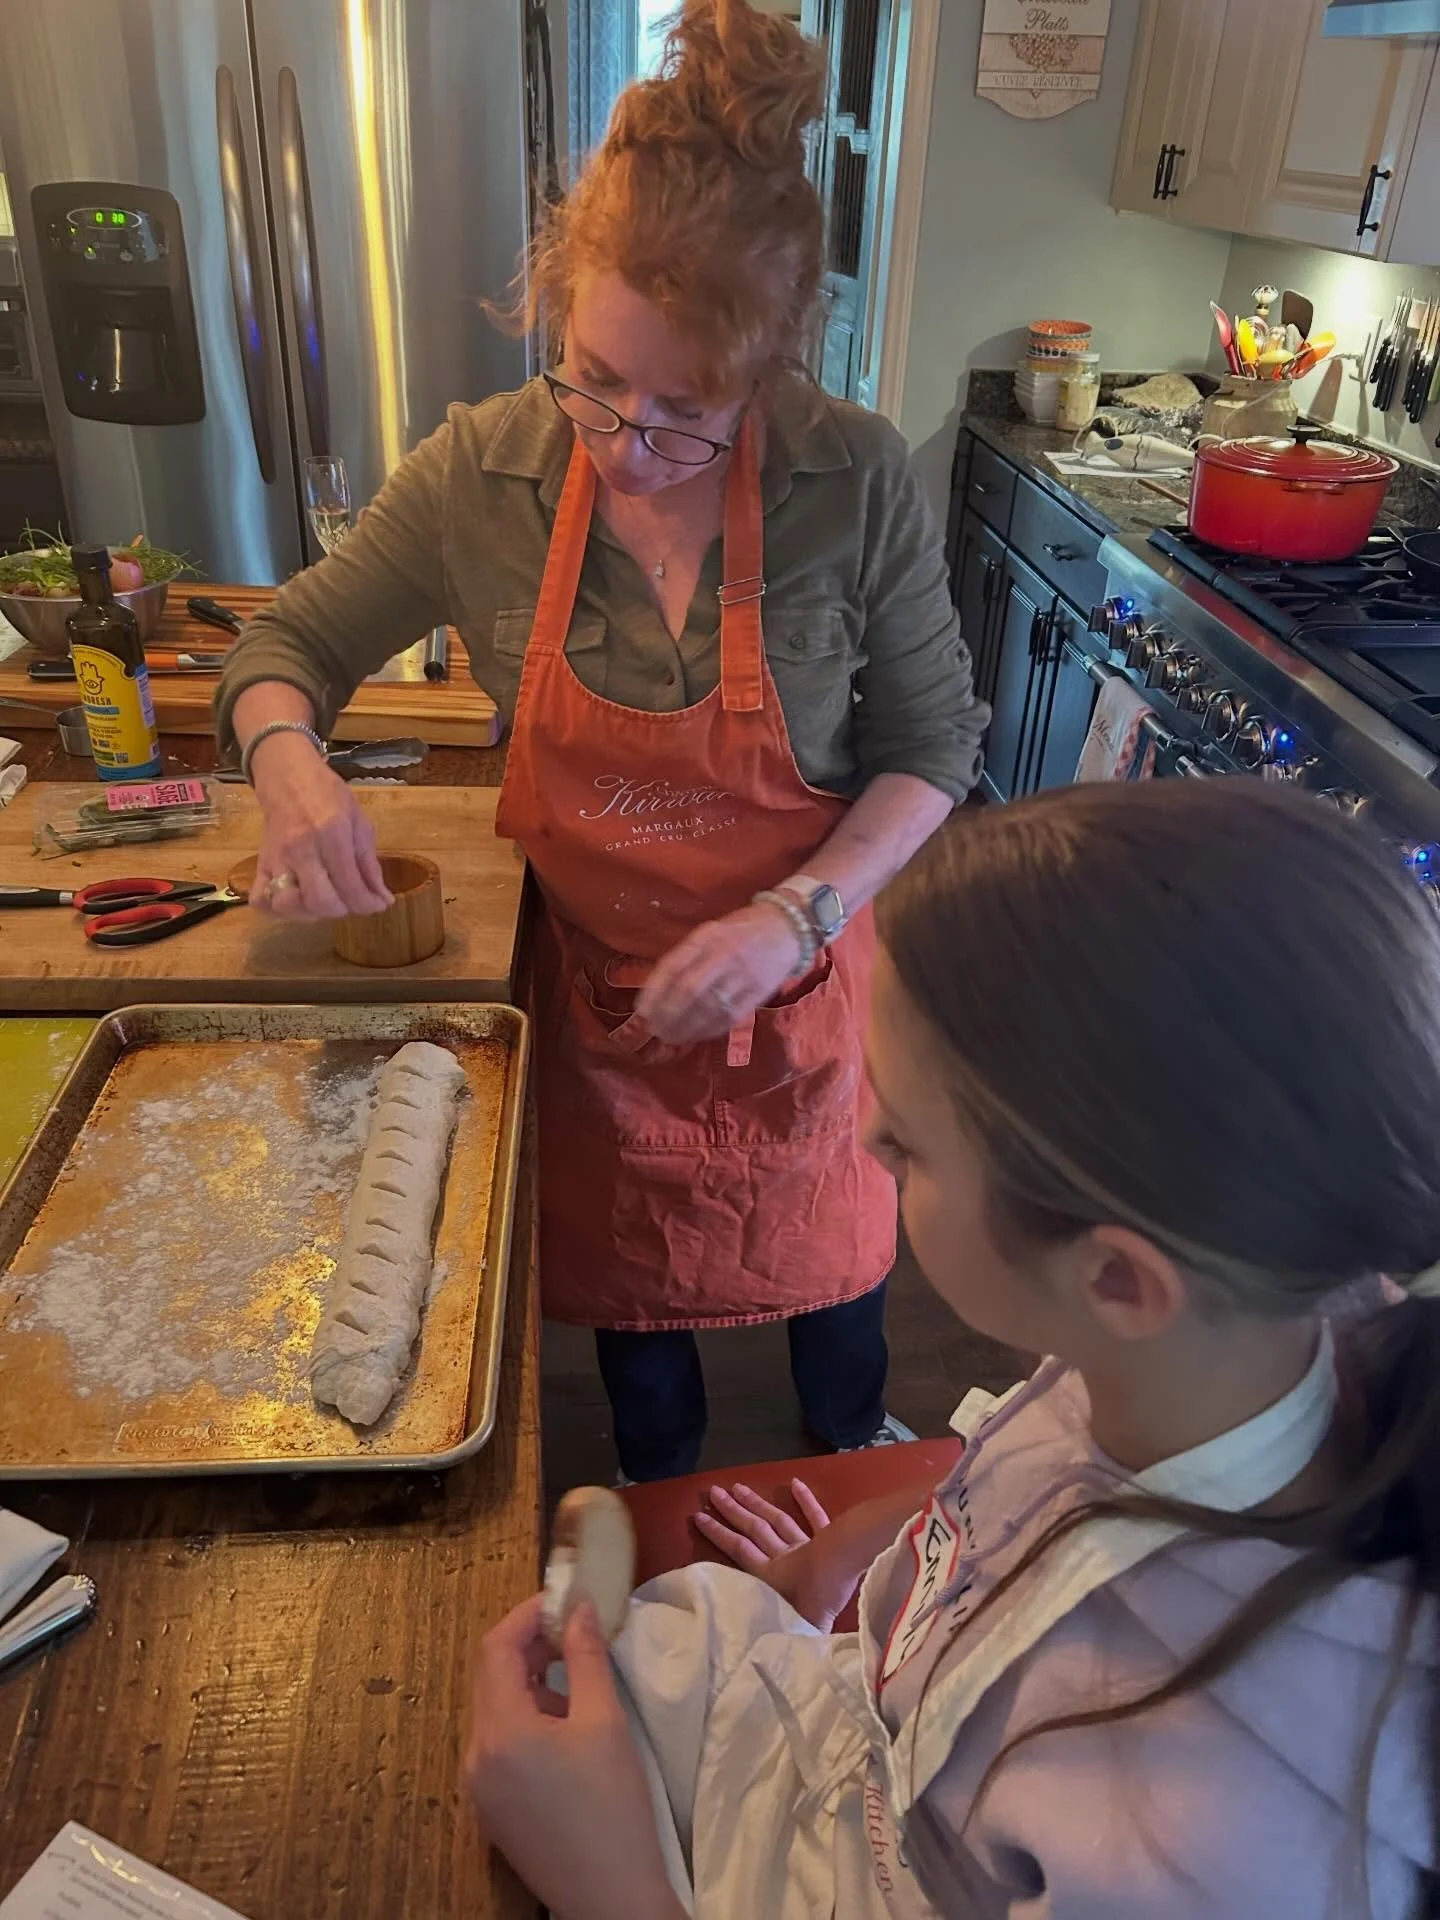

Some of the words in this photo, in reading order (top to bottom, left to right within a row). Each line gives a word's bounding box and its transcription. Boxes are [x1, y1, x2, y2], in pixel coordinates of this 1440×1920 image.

[155, 784, 180, 805] SAGE
[631, 815, 704, 834] MARGAUX
[605, 837, 651, 851] GRAND
[865, 1783, 894, 1892] Kitchen
